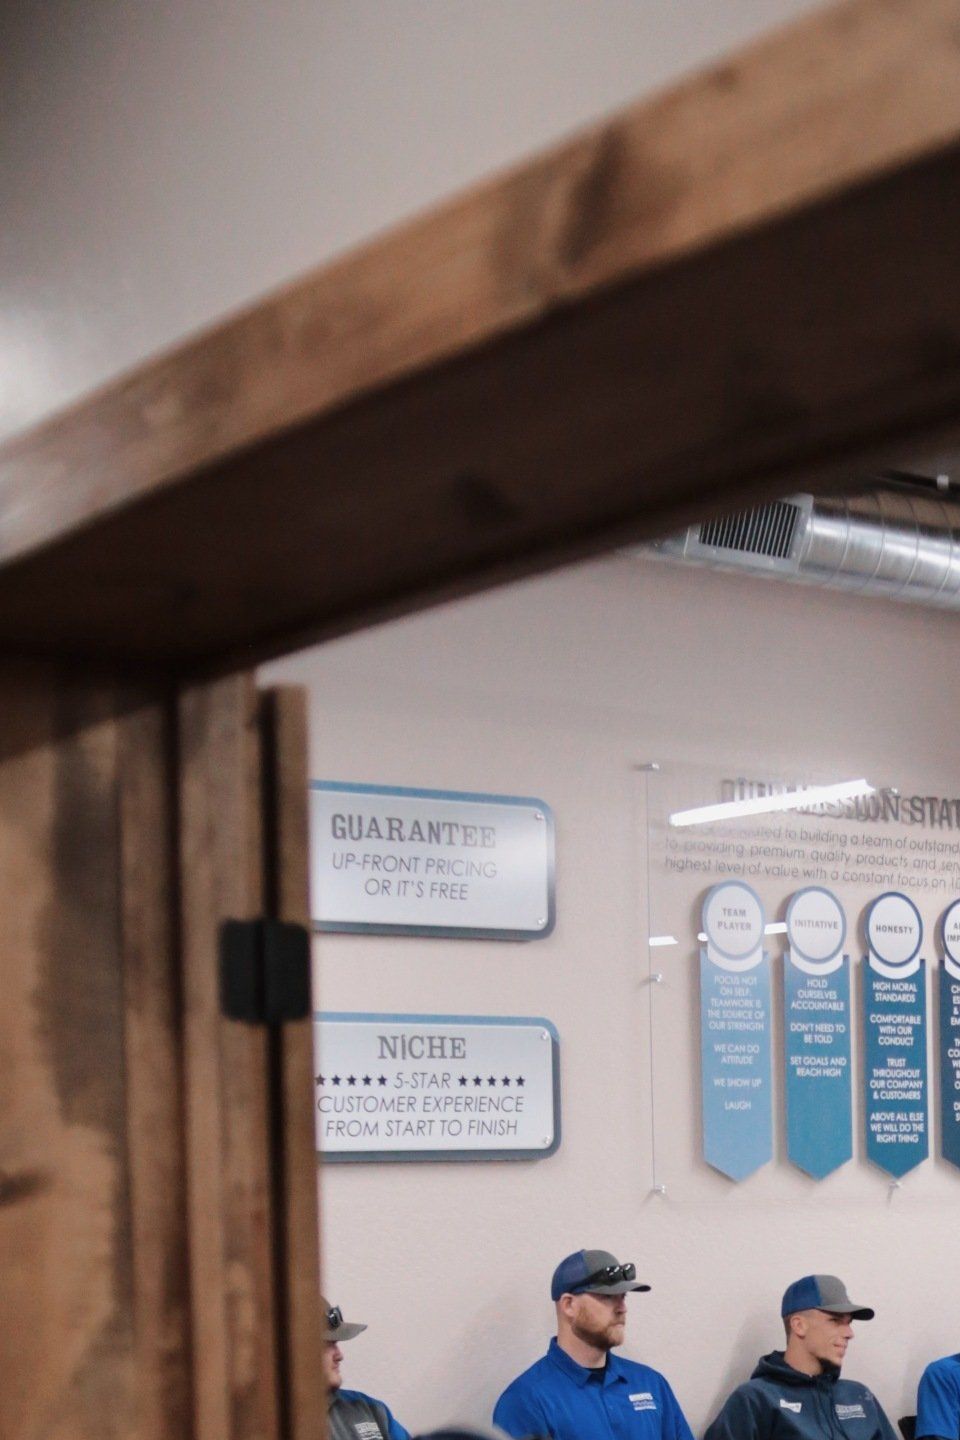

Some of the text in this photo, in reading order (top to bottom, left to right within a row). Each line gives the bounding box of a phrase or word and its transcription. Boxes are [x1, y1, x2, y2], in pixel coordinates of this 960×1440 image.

[331, 813, 496, 849] GUARANTEE
[332, 852, 497, 878] UP-FRONT PRICING
[364, 878, 468, 900] OR IT'S FREE
[795, 919, 838, 929] INITIATIVE
[876, 925, 913, 934] HONESTY
[807, 979, 828, 988] HOLD
[873, 981, 917, 992] HIGH MORAL
[875, 992, 916, 1003] STANDARDS
[791, 1001, 844, 1011] ACCOUNTABLE
[870, 1014, 921, 1024] COMFORTABLE
[879, 1026, 912, 1035] WITH OUR
[878, 1036, 914, 1046] CONDUCT
[377, 1034, 467, 1060] NICHE
[790, 1056, 847, 1066] SET GOALS AND
[887, 1058, 906, 1067] TRUST
[797, 1067, 841, 1076] REACH HIGH
[873, 1069, 920, 1078] THROUGHOUT
[394, 1072, 451, 1089] 5-STAR
[870, 1079, 923, 1089] OUR COMPANY
[880, 1091, 921, 1100] CUSTOMERS
[317, 1096, 524, 1113] CUSTOMER EXPERIENCE
[725, 1101, 751, 1110] LAUGH
[870, 1112, 924, 1121] ABOVE ALL ELSE
[325, 1119, 518, 1137] FROM START TO FINISH
[870, 1123, 924, 1132] WE WILL DO THE
[877, 1134, 919, 1143] RIGHT THING
